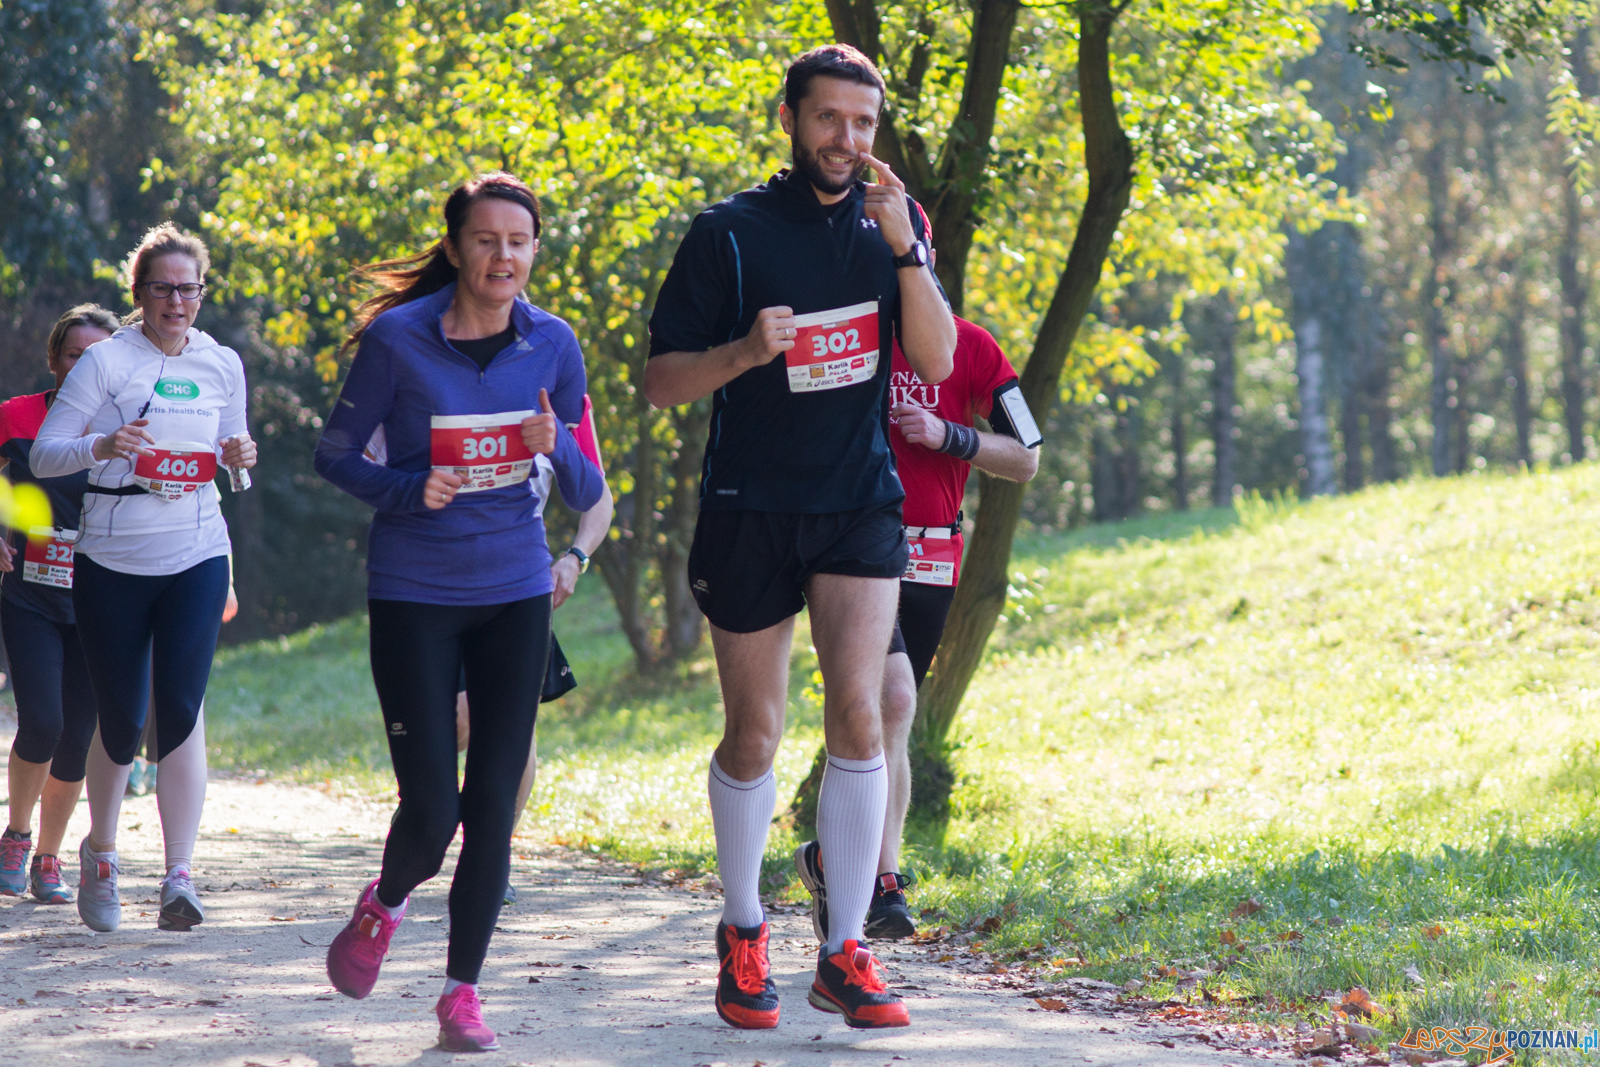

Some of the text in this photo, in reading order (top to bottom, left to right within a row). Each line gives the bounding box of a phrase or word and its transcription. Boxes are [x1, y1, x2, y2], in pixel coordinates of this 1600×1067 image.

[811, 328, 861, 357] 302
[828, 361, 849, 371] Karlik
[163, 384, 193, 396] CHC
[889, 385, 941, 409] IKU
[168, 406, 195, 415] Health
[196, 408, 214, 417] Caps
[462, 435, 508, 460] 301
[156, 457, 199, 477] 406
[472, 466, 494, 475] Karlik
